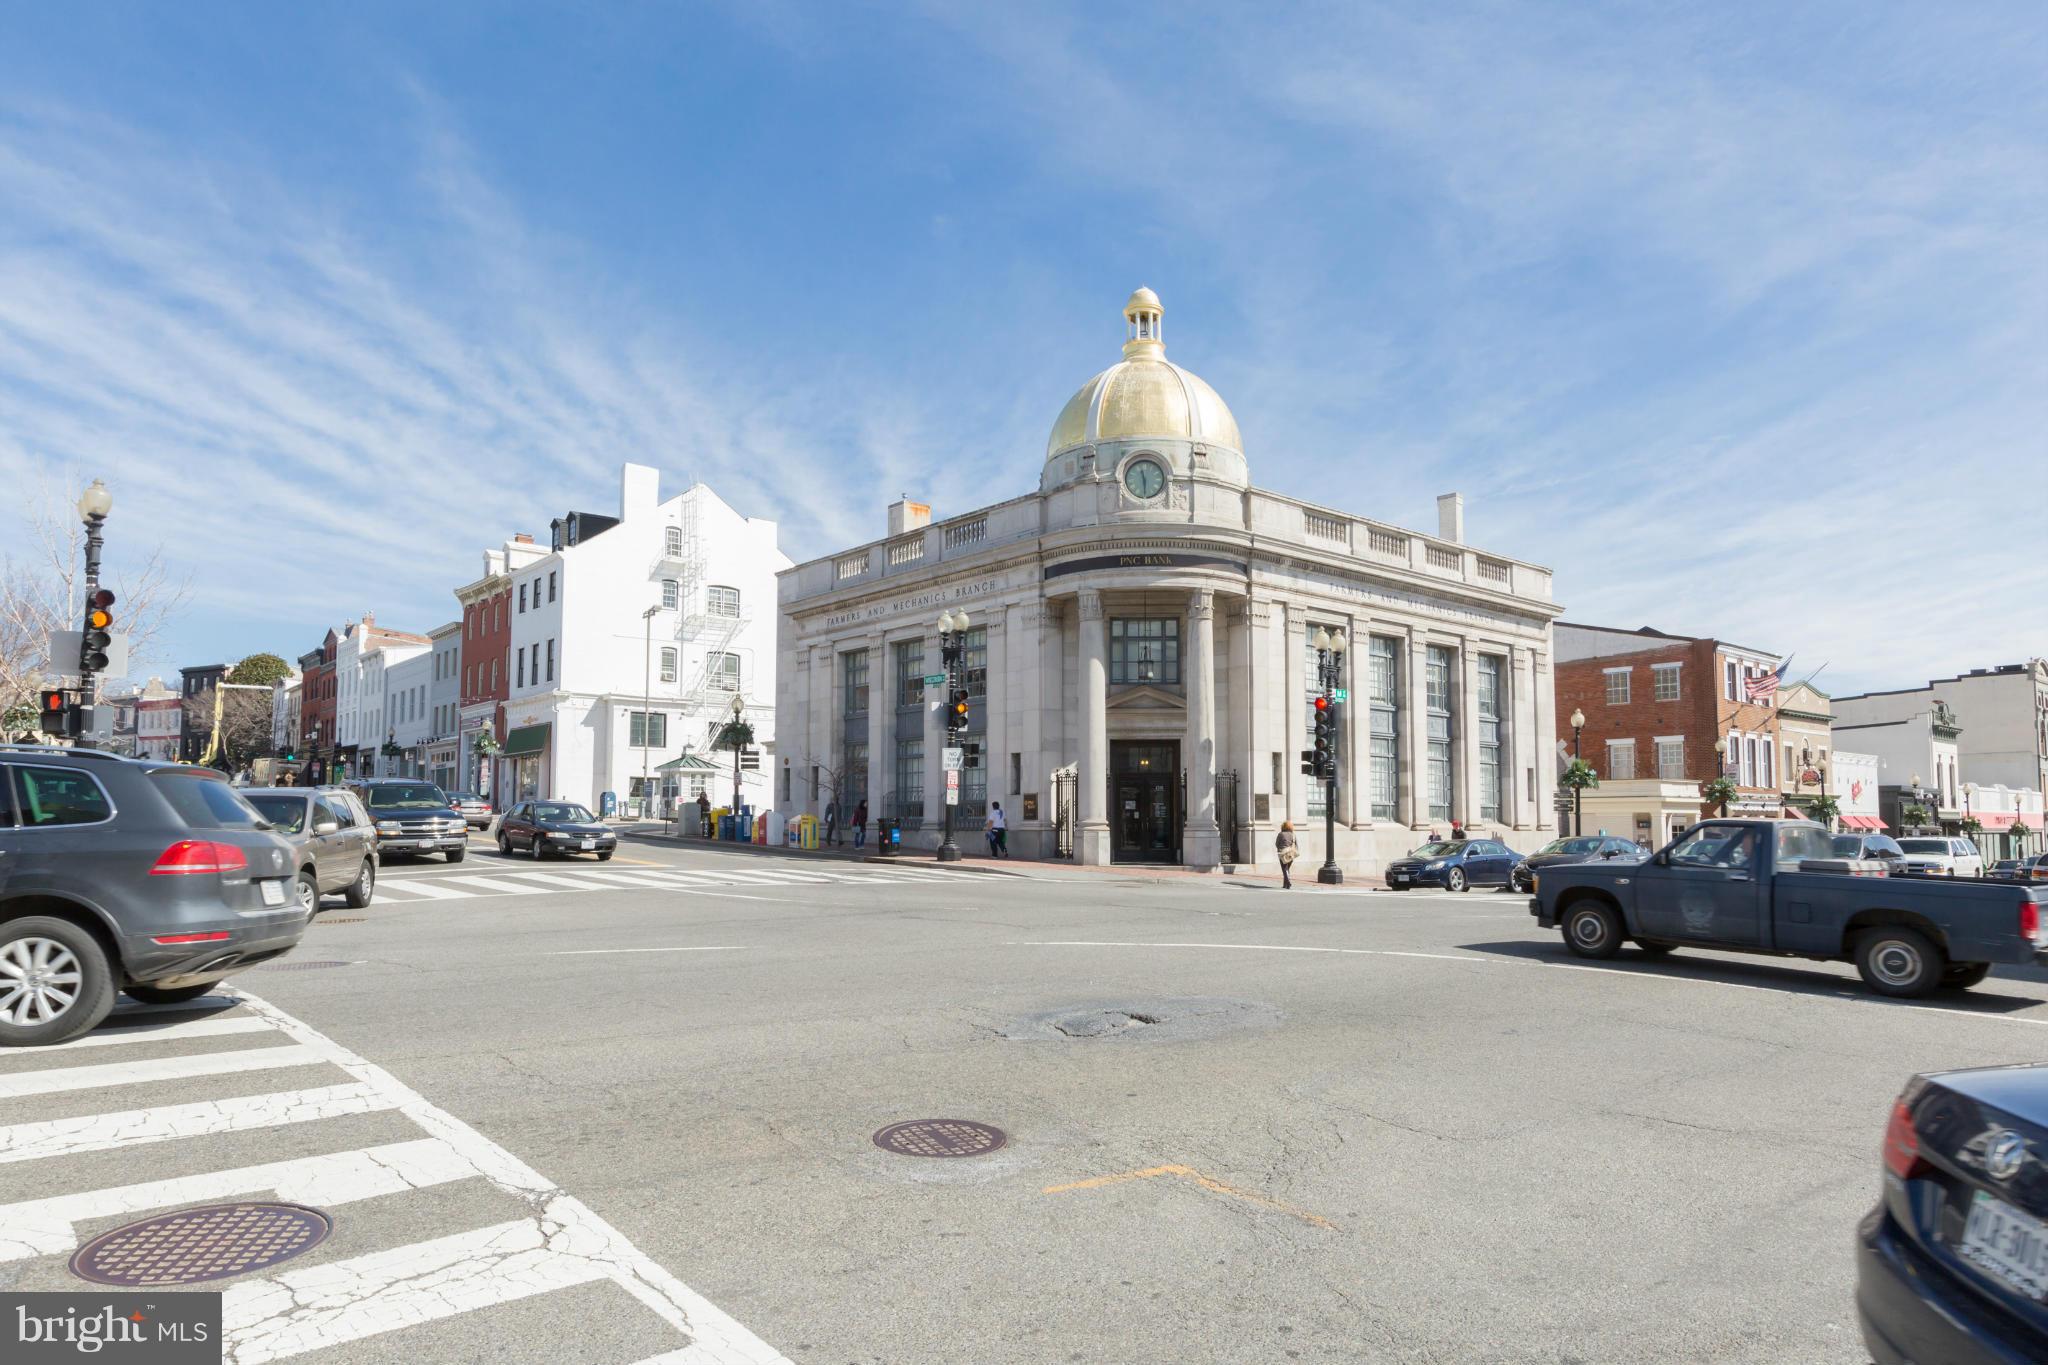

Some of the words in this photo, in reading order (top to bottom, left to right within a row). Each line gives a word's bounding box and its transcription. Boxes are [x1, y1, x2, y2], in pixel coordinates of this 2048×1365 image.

[1120, 556, 1140, 566] PNC
[1144, 555, 1175, 566] BANK
[826, 613, 861, 626] FARMERS
[868, 606, 885, 618] AND
[893, 592, 946, 610] MECHANICS
[955, 580, 996, 597] BRANCH
[1329, 583, 1372, 600] FARMERS
[1381, 594, 1399, 605] AND
[1407, 599, 1457, 617] MECHANICS
